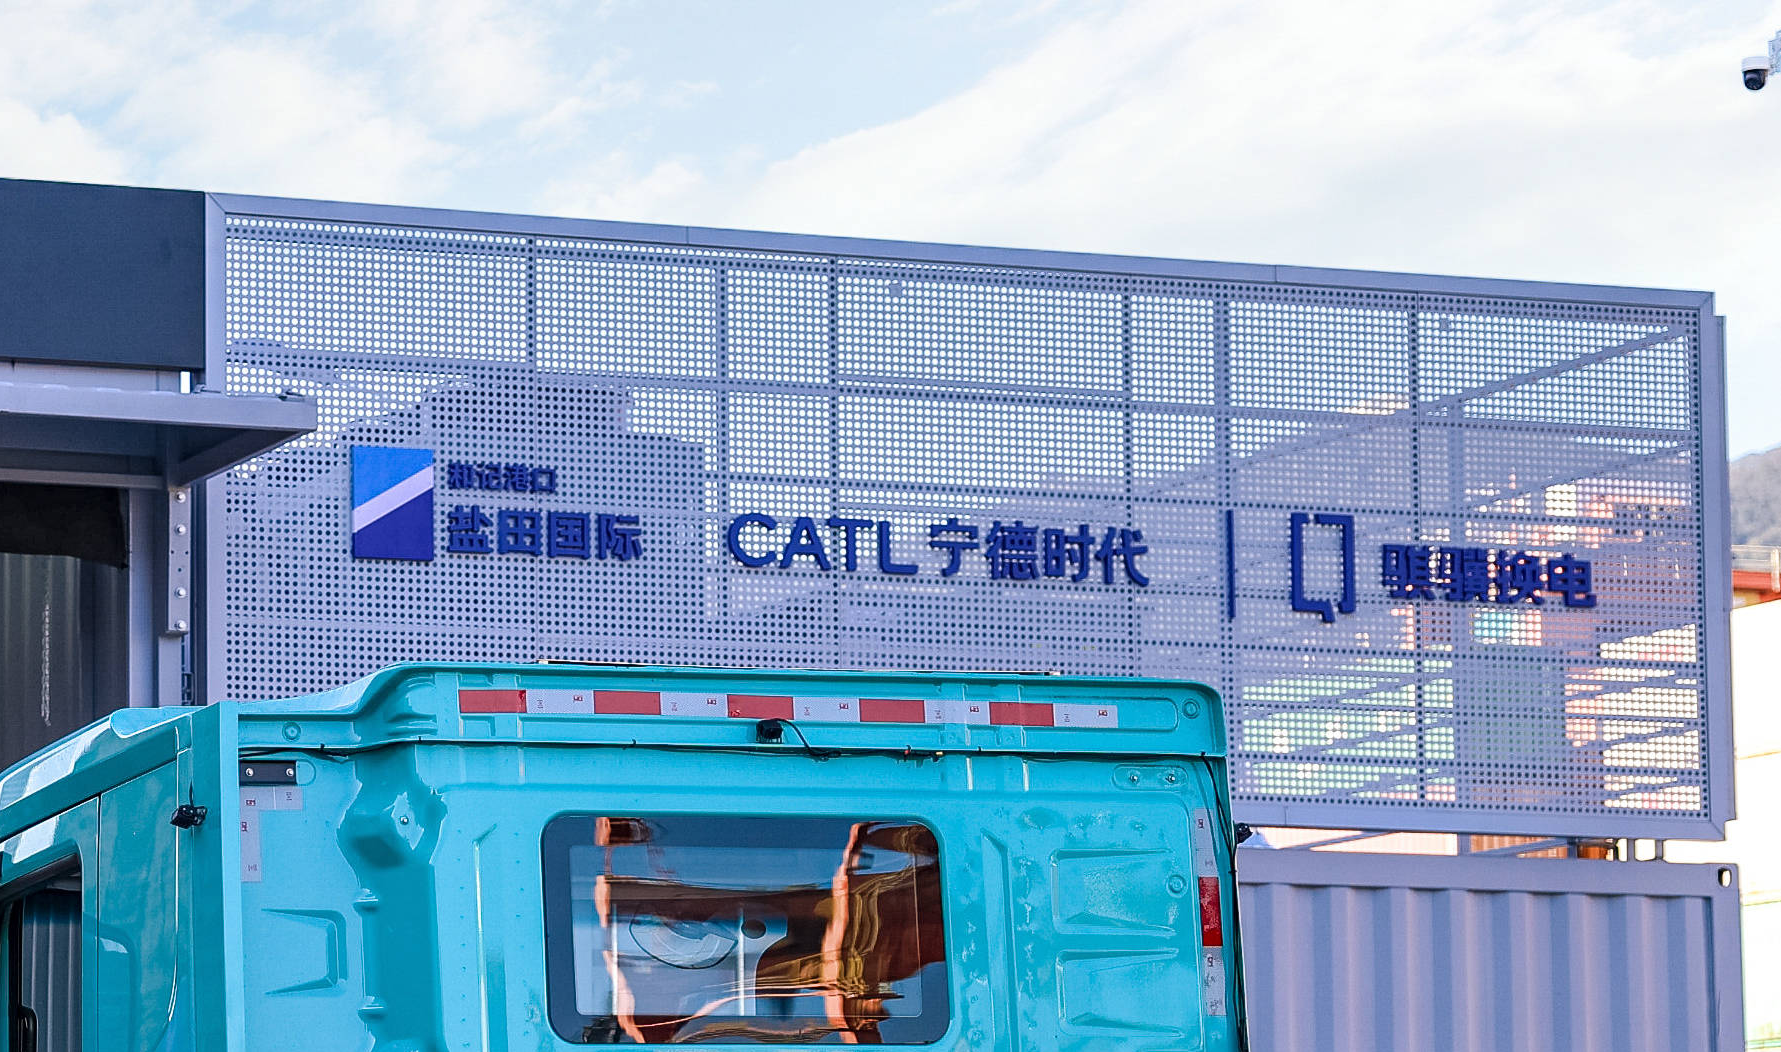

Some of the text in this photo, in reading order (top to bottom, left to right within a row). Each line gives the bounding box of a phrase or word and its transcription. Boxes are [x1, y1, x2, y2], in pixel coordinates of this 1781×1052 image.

[448, 504, 644, 561] 盐田国际
[726, 511, 1150, 588] CATL 宁德时代
